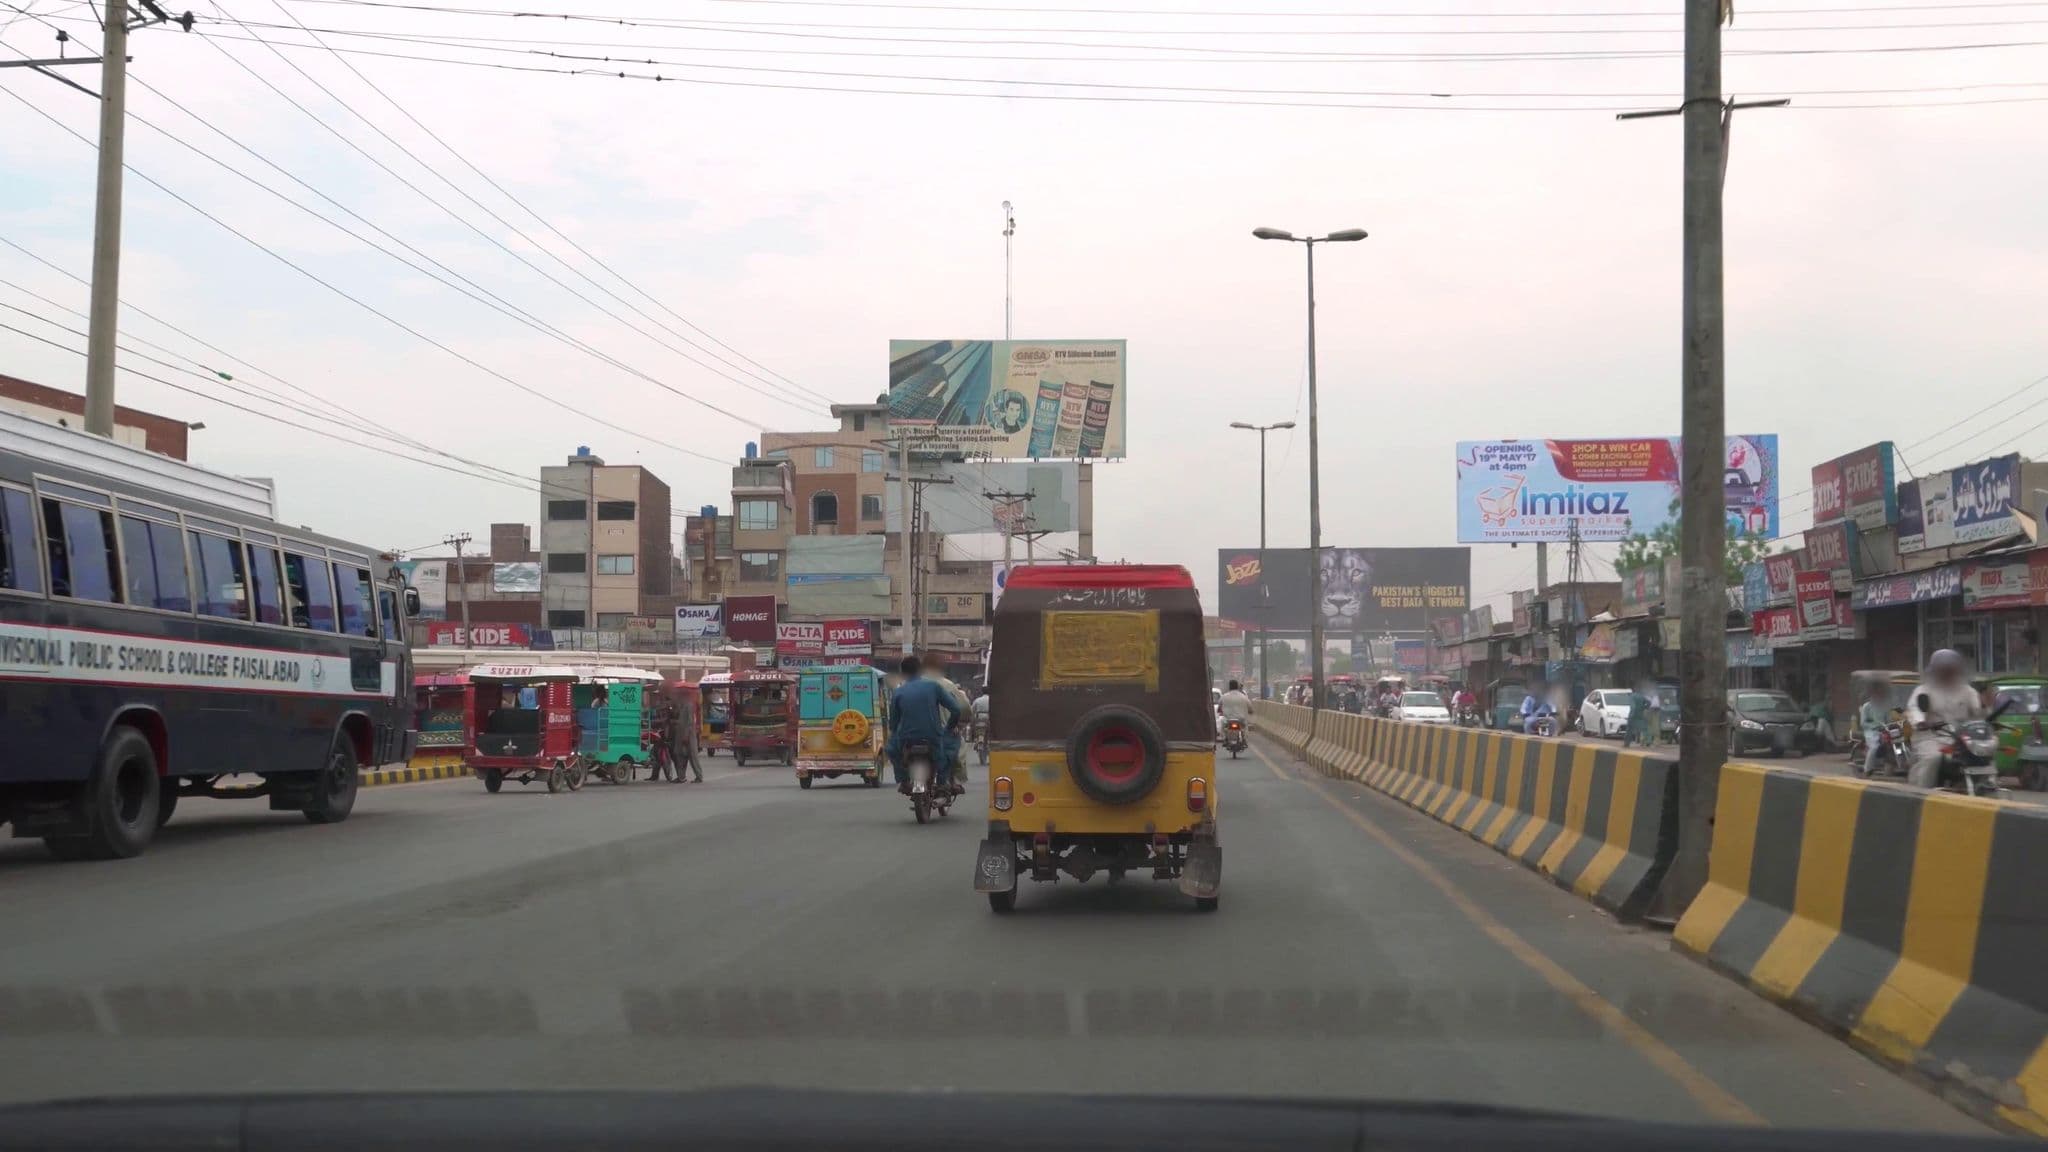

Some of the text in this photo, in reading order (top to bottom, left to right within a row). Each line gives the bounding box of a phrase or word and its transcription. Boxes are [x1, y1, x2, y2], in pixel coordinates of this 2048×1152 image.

[1485, 444, 1533, 454] OPENING
[1572, 443, 1651, 453] SHOP & WIN CAR
[1499, 453, 1522, 462] MAY
[1489, 463, 1527, 472] at 4pm
[1845, 459, 1878, 495] EXIDE
[1522, 484, 1629, 516] Imtiaz
[1808, 530, 1842, 563] EXIDE
[1226, 560, 1261, 584] Jazz
[1372, 586, 1421, 597] PAKISTAN'S
[1798, 581, 1831, 593] EXIDE
[957, 597, 972, 606] ZIC
[1380, 597, 1401, 608] BEST
[1402, 597, 1424, 607] DATA
[678, 608, 711, 619] OSAKA
[732, 612, 769, 622] HOMAGE
[455, 628, 510, 645] EXIDE
[780, 626, 822, 638] VOLTA
[829, 628, 865, 640] EXIDE
[0, 635, 300, 683] VISIONAL PUBLIC SCHOOL & COLLEGE FAISALABAD
[783, 656, 814, 667] OSAKA
[833, 657, 862, 666] EXIDE
[491, 667, 533, 675] SUZUKI
